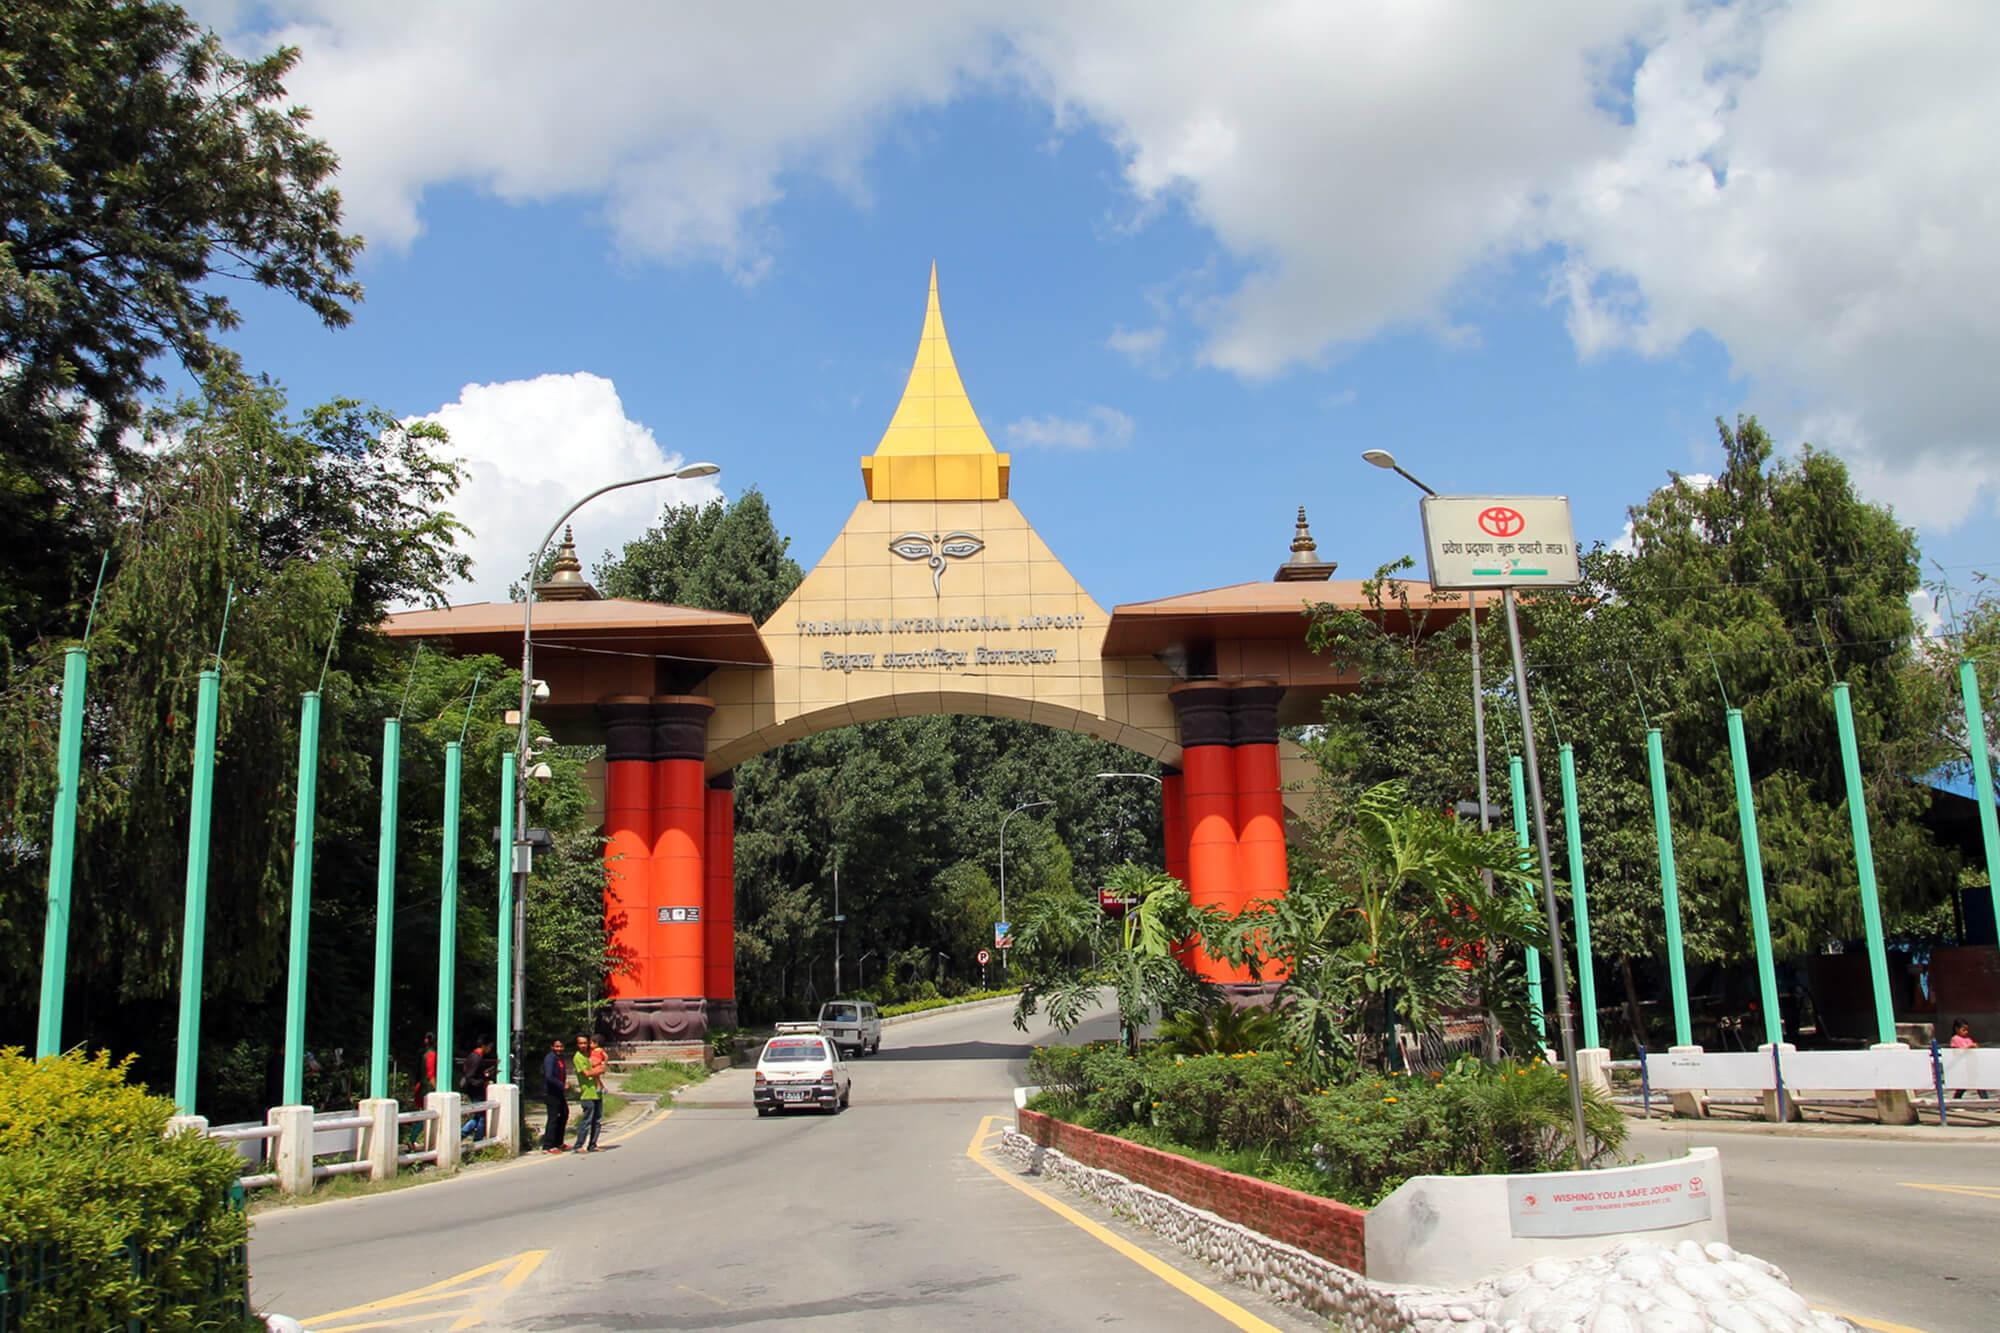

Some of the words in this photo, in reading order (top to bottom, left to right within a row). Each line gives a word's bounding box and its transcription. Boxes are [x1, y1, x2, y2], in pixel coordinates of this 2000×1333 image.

[796, 617, 883, 636] TRIBHUVAN
[889, 615, 1012, 634] INTERNATIONAL
[1018, 612, 1085, 630] AIRPORT
[821, 650, 875, 674] त्रिभुवन
[975, 646, 1057, 666] विमानस्थल
[1553, 1192, 1595, 1203] WISHING
[1598, 1191, 1616, 1200] YOU
[1618, 1190, 1624, 1198] A
[1626, 1187, 1648, 1197] SAFE
[1650, 1183, 1682, 1196] JOURNEY
